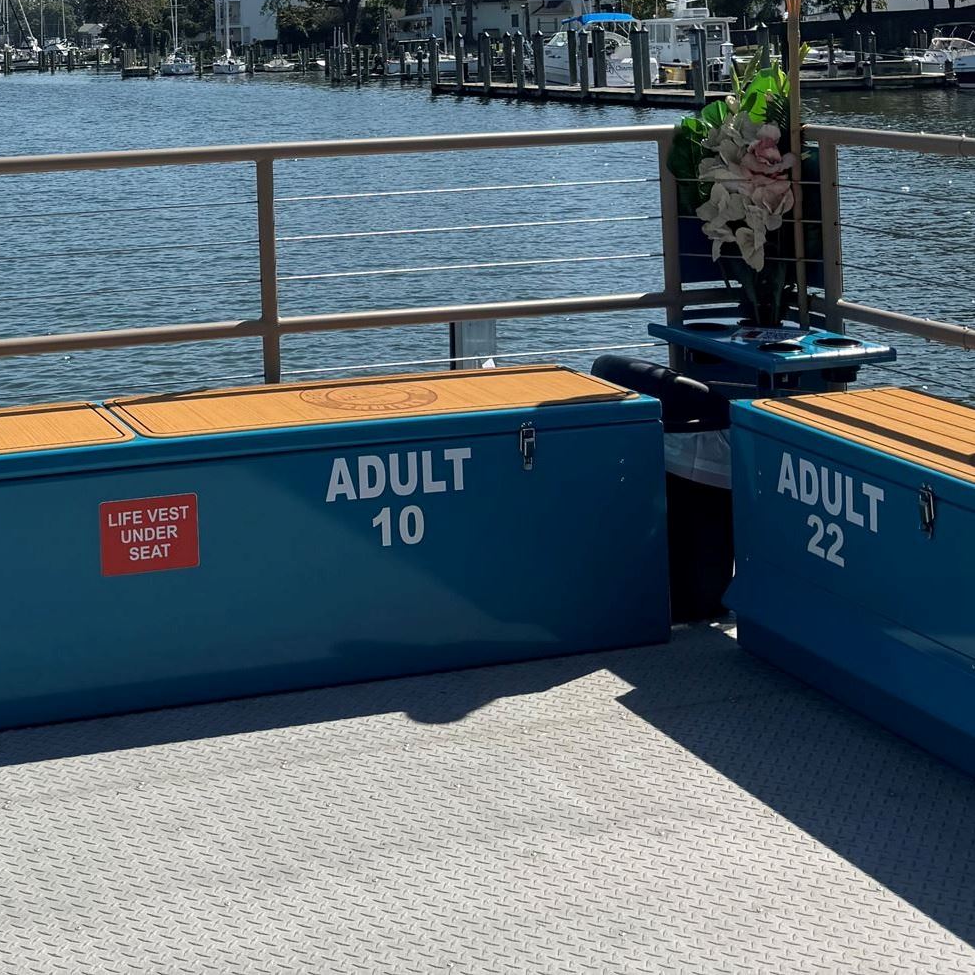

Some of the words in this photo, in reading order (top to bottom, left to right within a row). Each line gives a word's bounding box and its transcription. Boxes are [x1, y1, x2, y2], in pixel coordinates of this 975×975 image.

[325, 447, 472, 502] ADULT
[777, 452, 885, 533] ADULT
[108, 510, 143, 527] LIFE
[146, 505, 190, 523] VEST
[120, 525, 178, 544] UNDER
[372, 505, 425, 547] 10
[129, 543, 171, 561] SEAT
[807, 514, 845, 568] 22
